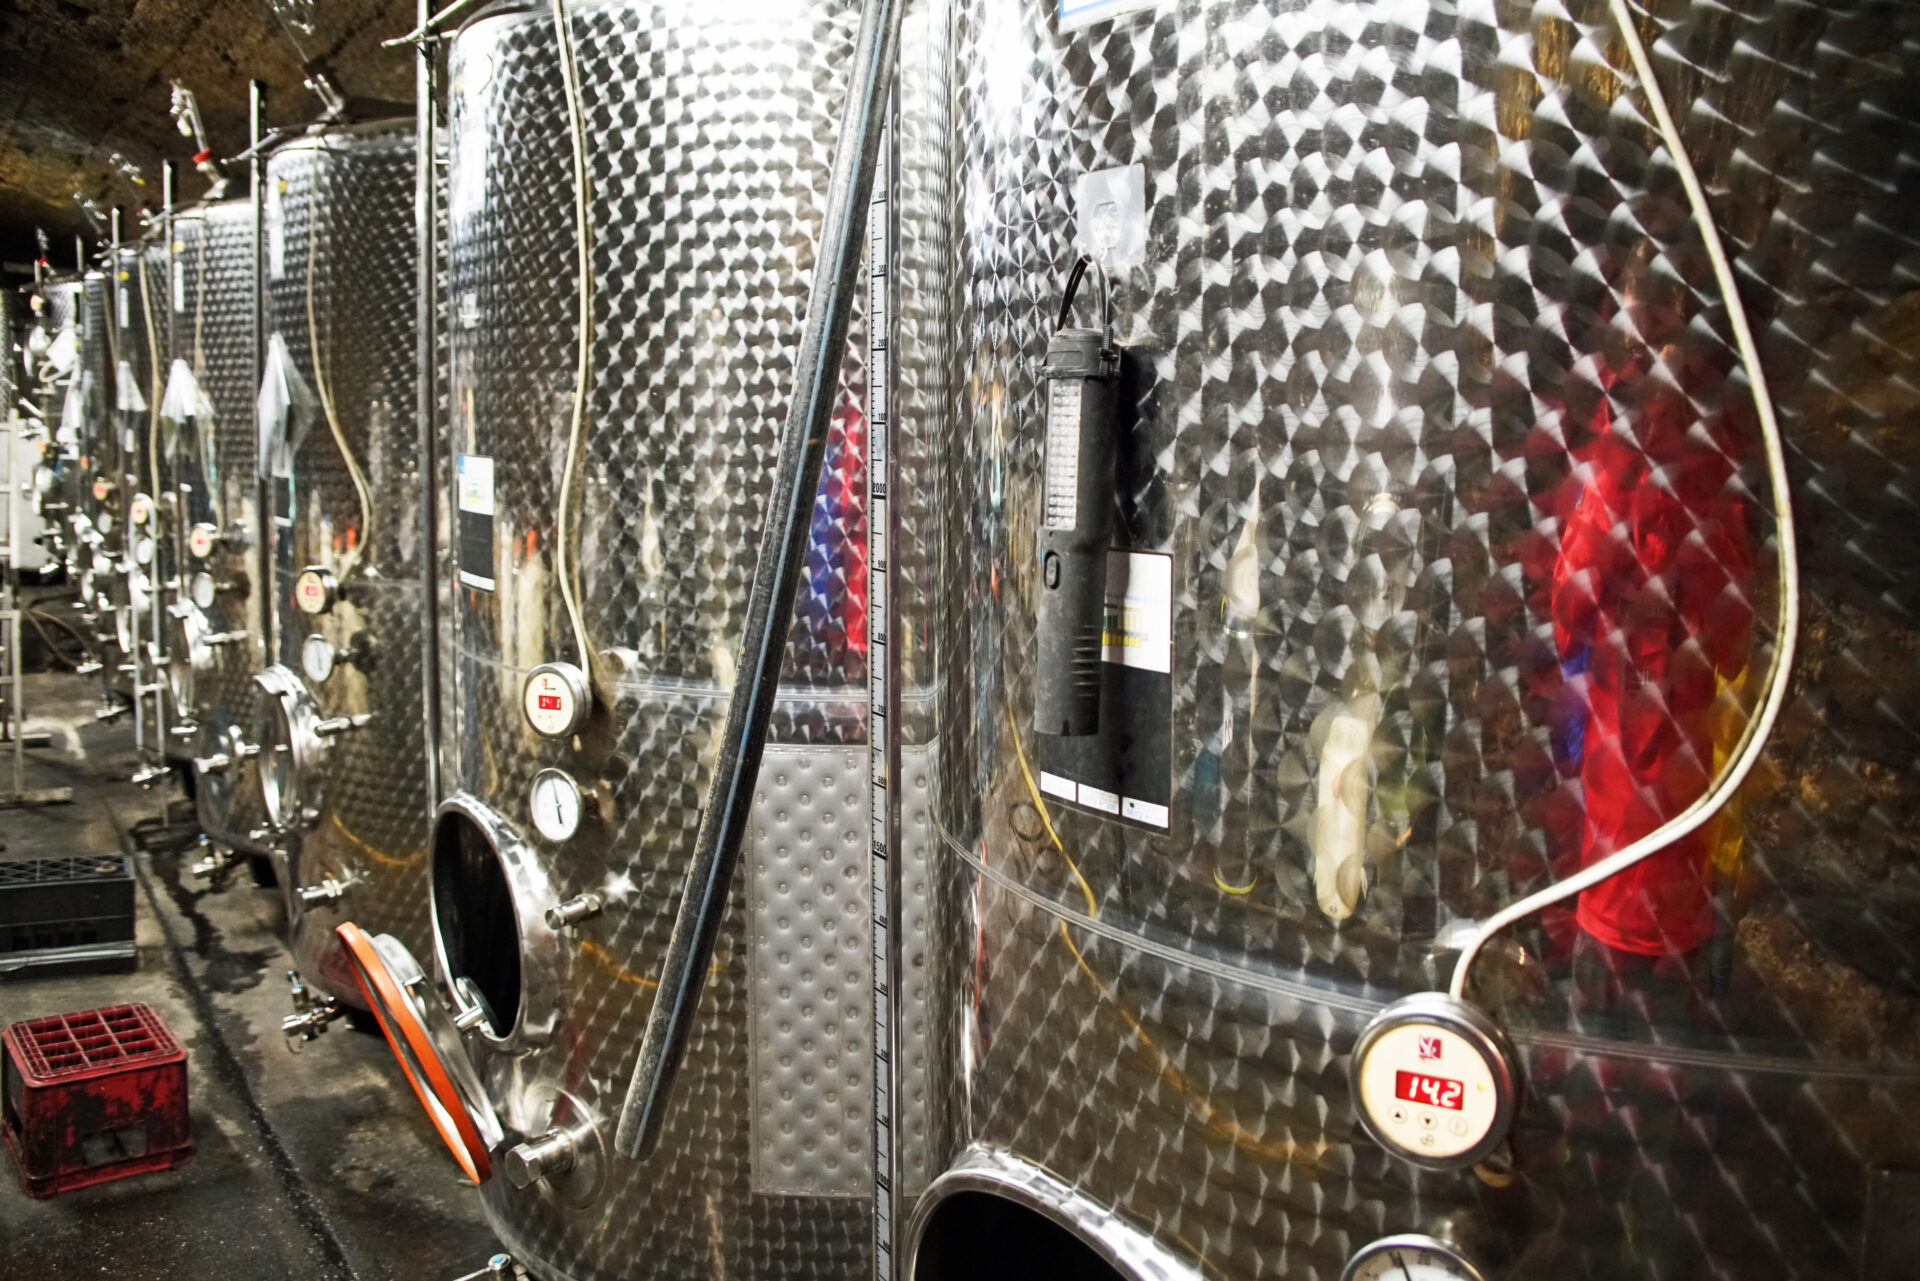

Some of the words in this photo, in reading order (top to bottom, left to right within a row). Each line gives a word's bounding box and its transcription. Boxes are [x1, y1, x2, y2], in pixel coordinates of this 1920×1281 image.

[878, 412, 887, 421] 100
[873, 482, 887, 494] 2000
[878, 560, 887, 569] 900
[878, 632, 887, 641] 800
[878, 704, 887, 714] 700
[878, 775, 887, 785] 600
[872, 841, 887, 855] 1500
[879, 915, 888, 925] 400
